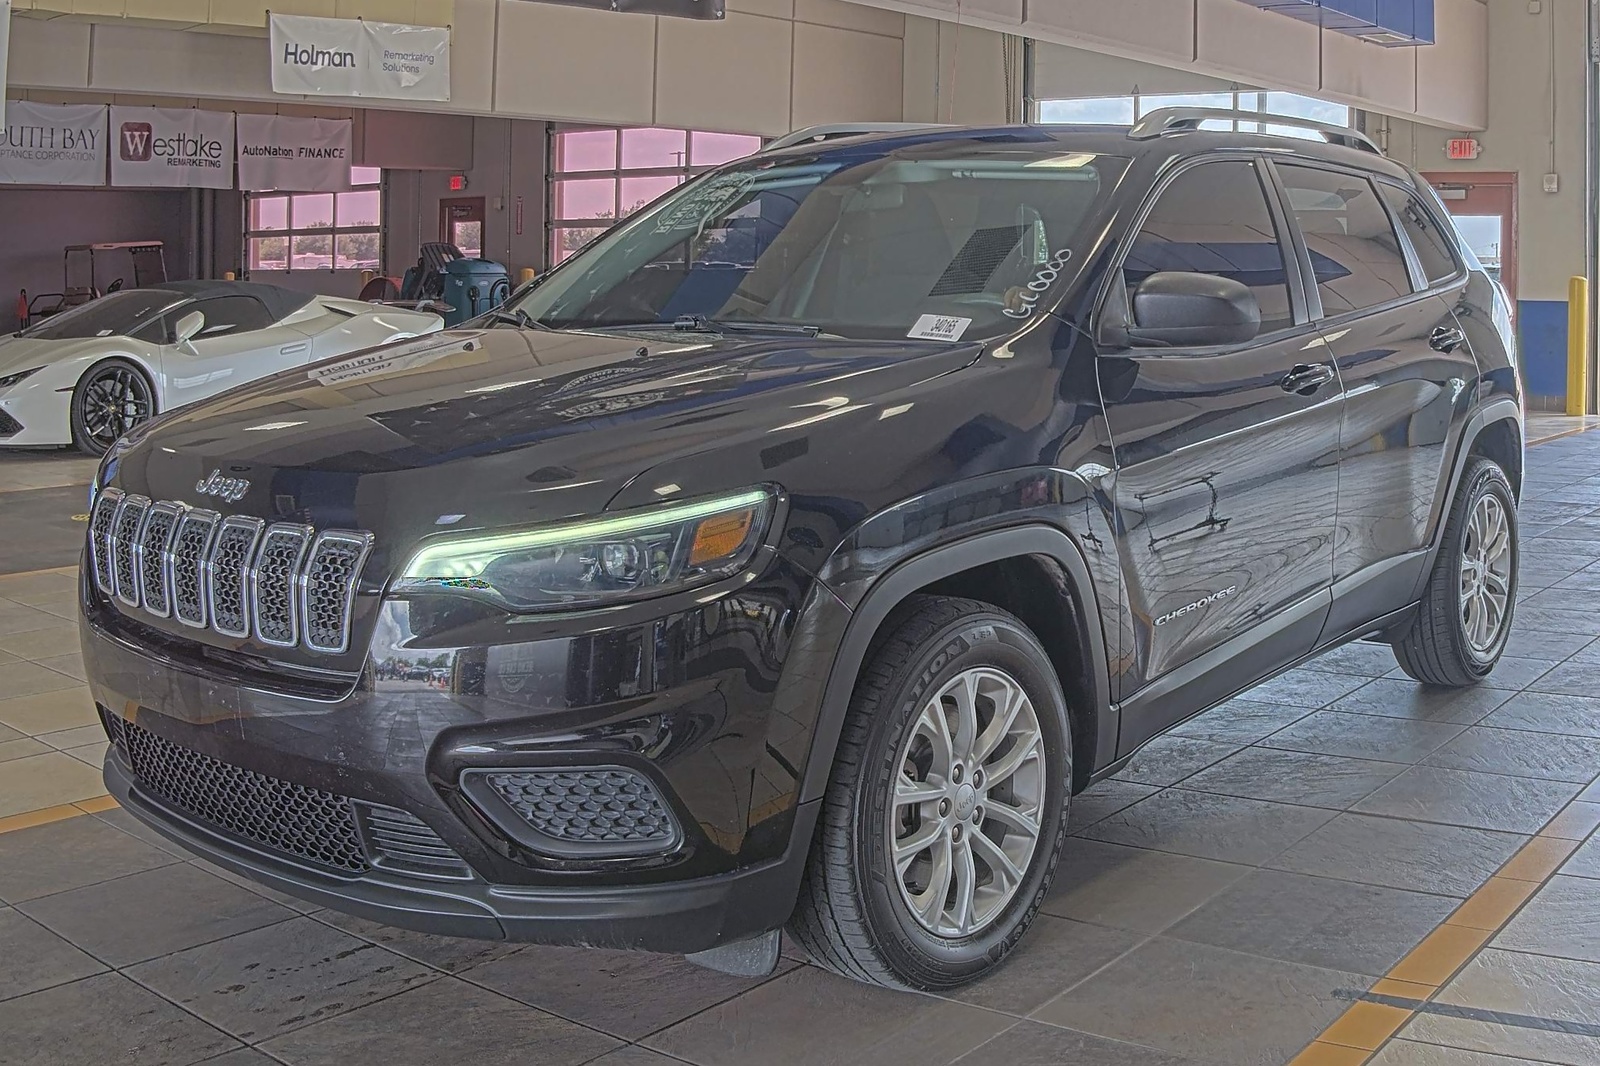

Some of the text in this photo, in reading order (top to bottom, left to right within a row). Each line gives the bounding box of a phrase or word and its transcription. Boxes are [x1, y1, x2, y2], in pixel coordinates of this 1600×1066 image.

[283, 43, 356, 68] Holman
[383, 49, 435, 65] Remarketing
[382, 62, 420, 74] Solutions
[62, 127, 100, 150] BAY
[122, 129, 222, 160] Westlake
[1451, 140, 1473, 158] EXIT
[35, 150, 96, 161] CORPORATION
[241, 144, 346, 159] AutoNation FINANCE
[166, 157, 221, 169] REMARKETING
[195, 468, 249, 504] Jeep
[1153, 585, 1236, 627] CHEROKEE
[872, 636, 964, 866] DESTINATION
[956, 792, 975, 813] Jeep
